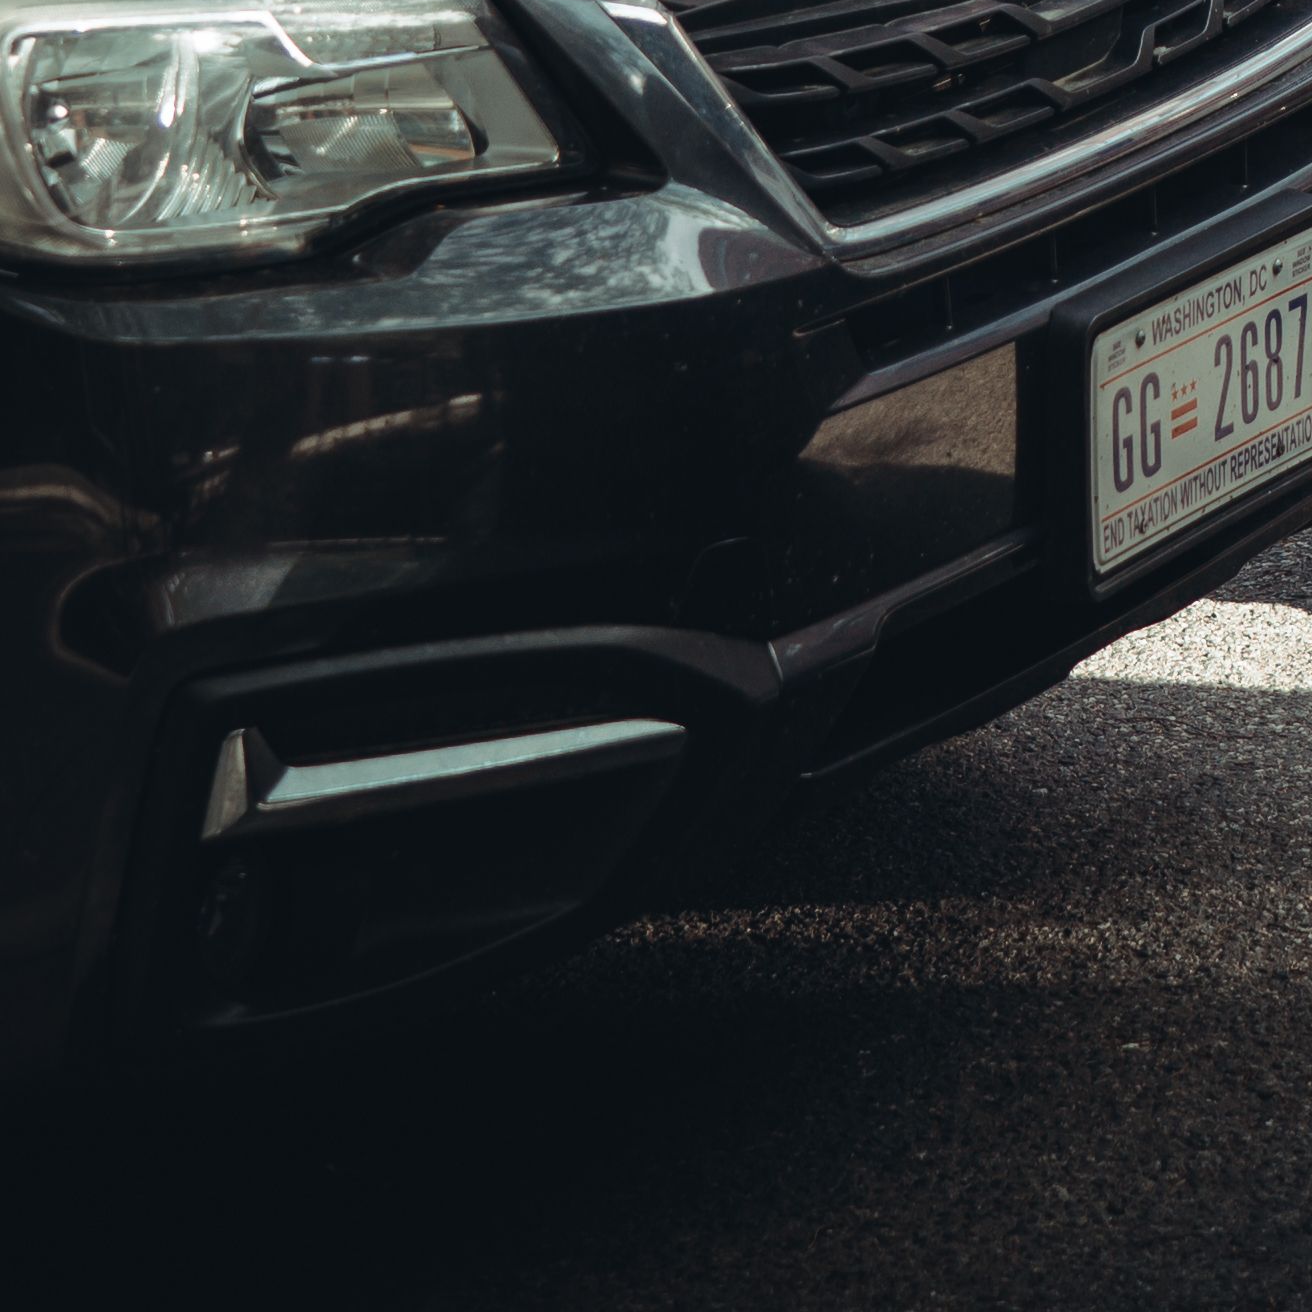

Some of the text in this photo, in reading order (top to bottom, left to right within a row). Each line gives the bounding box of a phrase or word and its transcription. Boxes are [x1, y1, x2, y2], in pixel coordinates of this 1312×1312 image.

[1152, 264, 1268, 346] WASHINGTON, DC
[1112, 293, 1308, 494] GG 2687
[1104, 514, 1125, 554] END
[1127, 488, 1178, 541] TAXATION
[1180, 458, 1228, 512] WITHOUT
